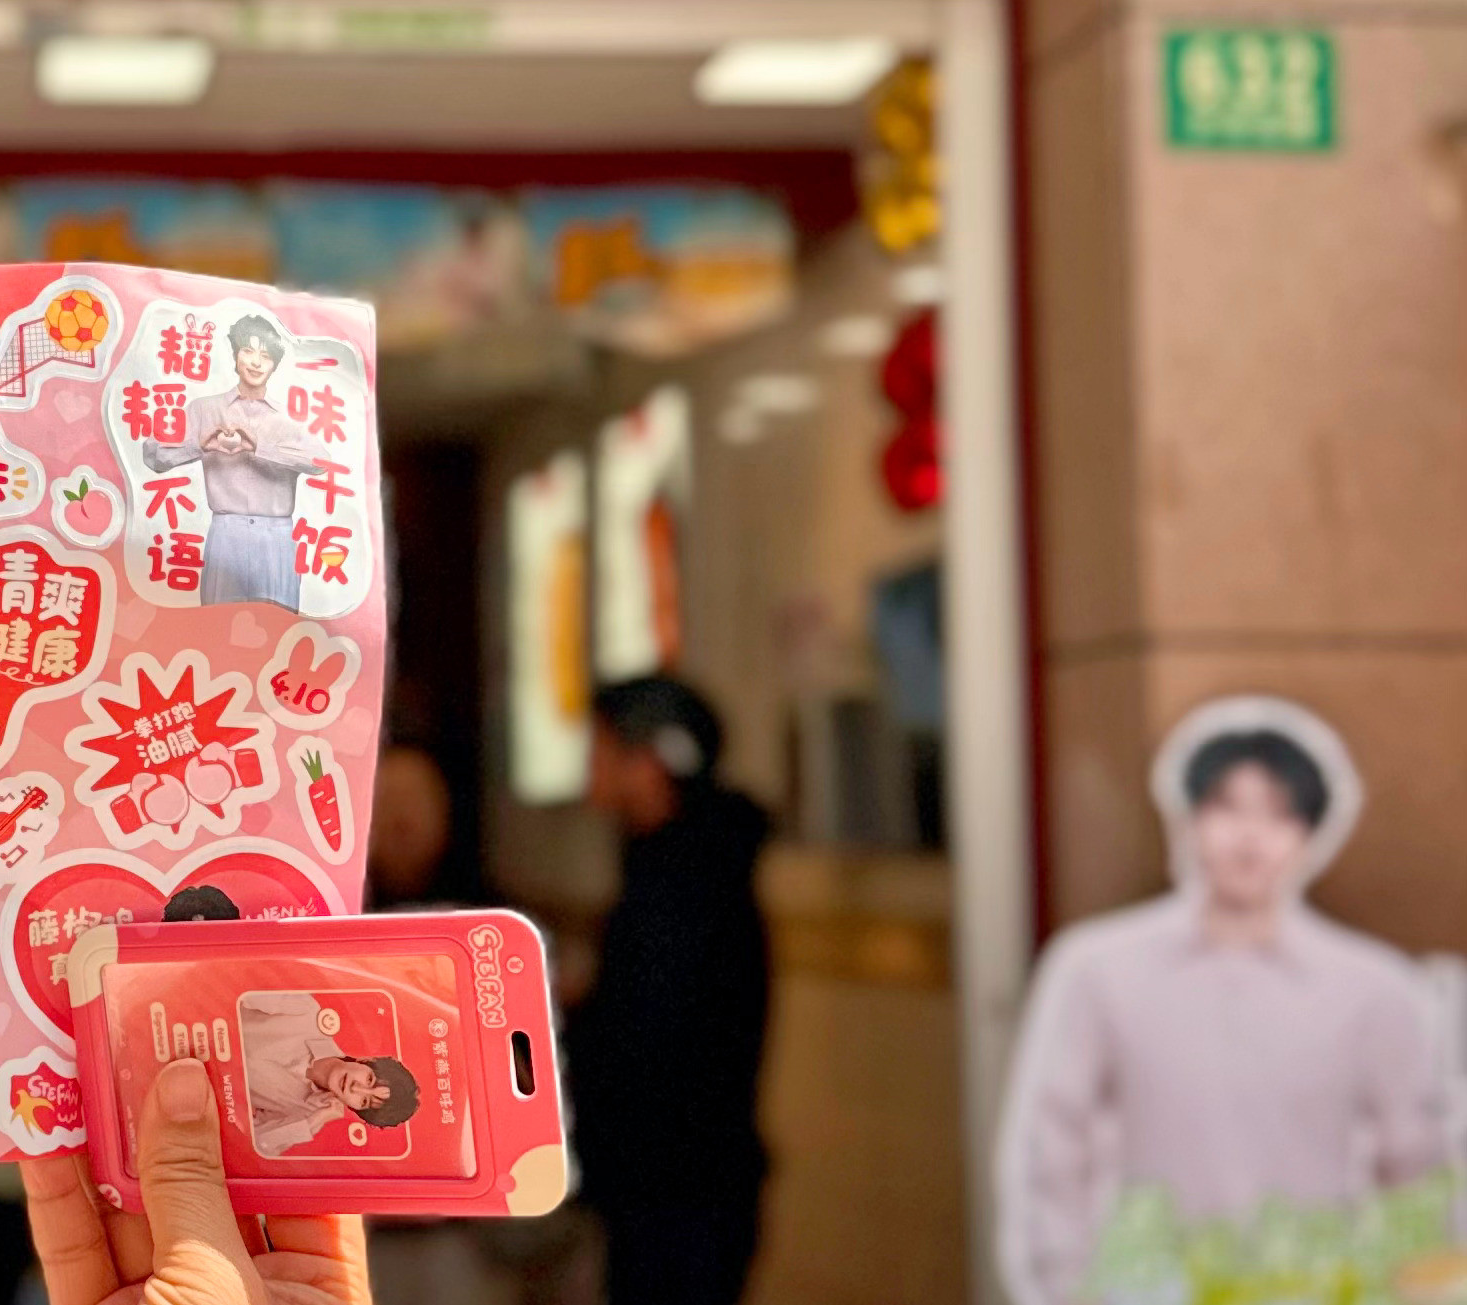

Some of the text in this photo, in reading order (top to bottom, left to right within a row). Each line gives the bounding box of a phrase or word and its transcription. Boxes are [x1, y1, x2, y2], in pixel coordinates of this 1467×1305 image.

[115, 701, 197, 740] 一拳打跑
[136, 722, 203, 768] 油腻
[468, 924, 507, 1028] STEFAN
[28, 1074, 79, 1106] STEFAN
